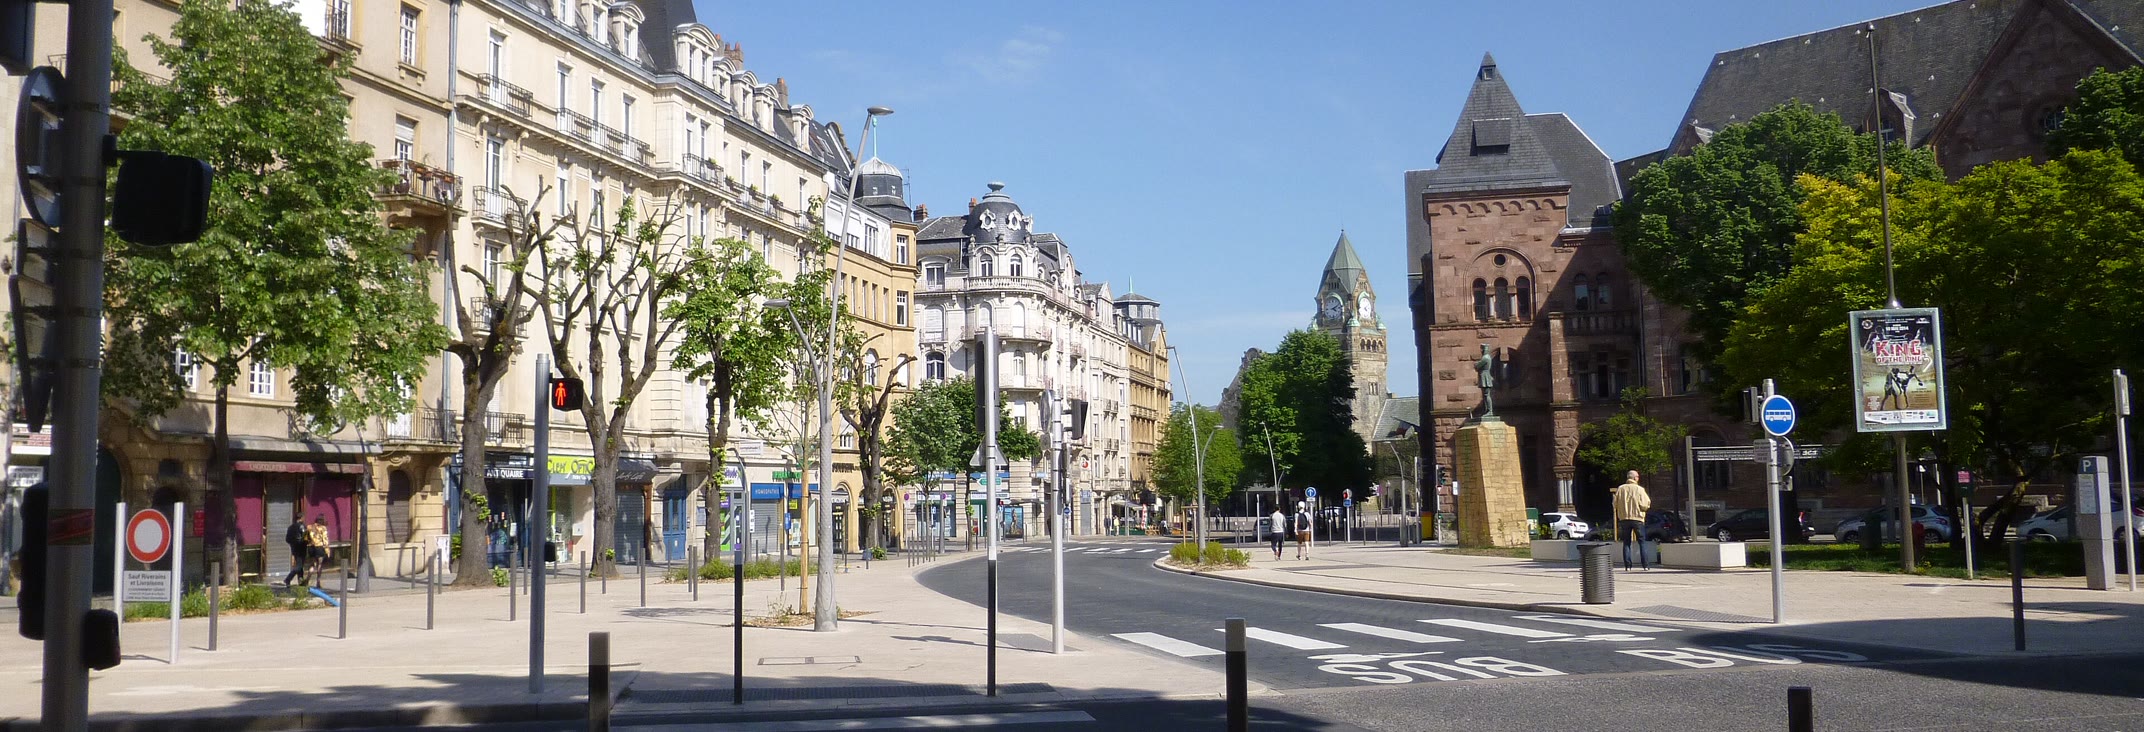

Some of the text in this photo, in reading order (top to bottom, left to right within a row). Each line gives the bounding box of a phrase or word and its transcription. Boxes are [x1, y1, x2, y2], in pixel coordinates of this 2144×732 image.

[1875, 340, 1921, 356] KING
[2083, 460, 2092, 472] P
[1615, 643, 1869, 669] BUS
[1318, 656, 1570, 684] BUS
